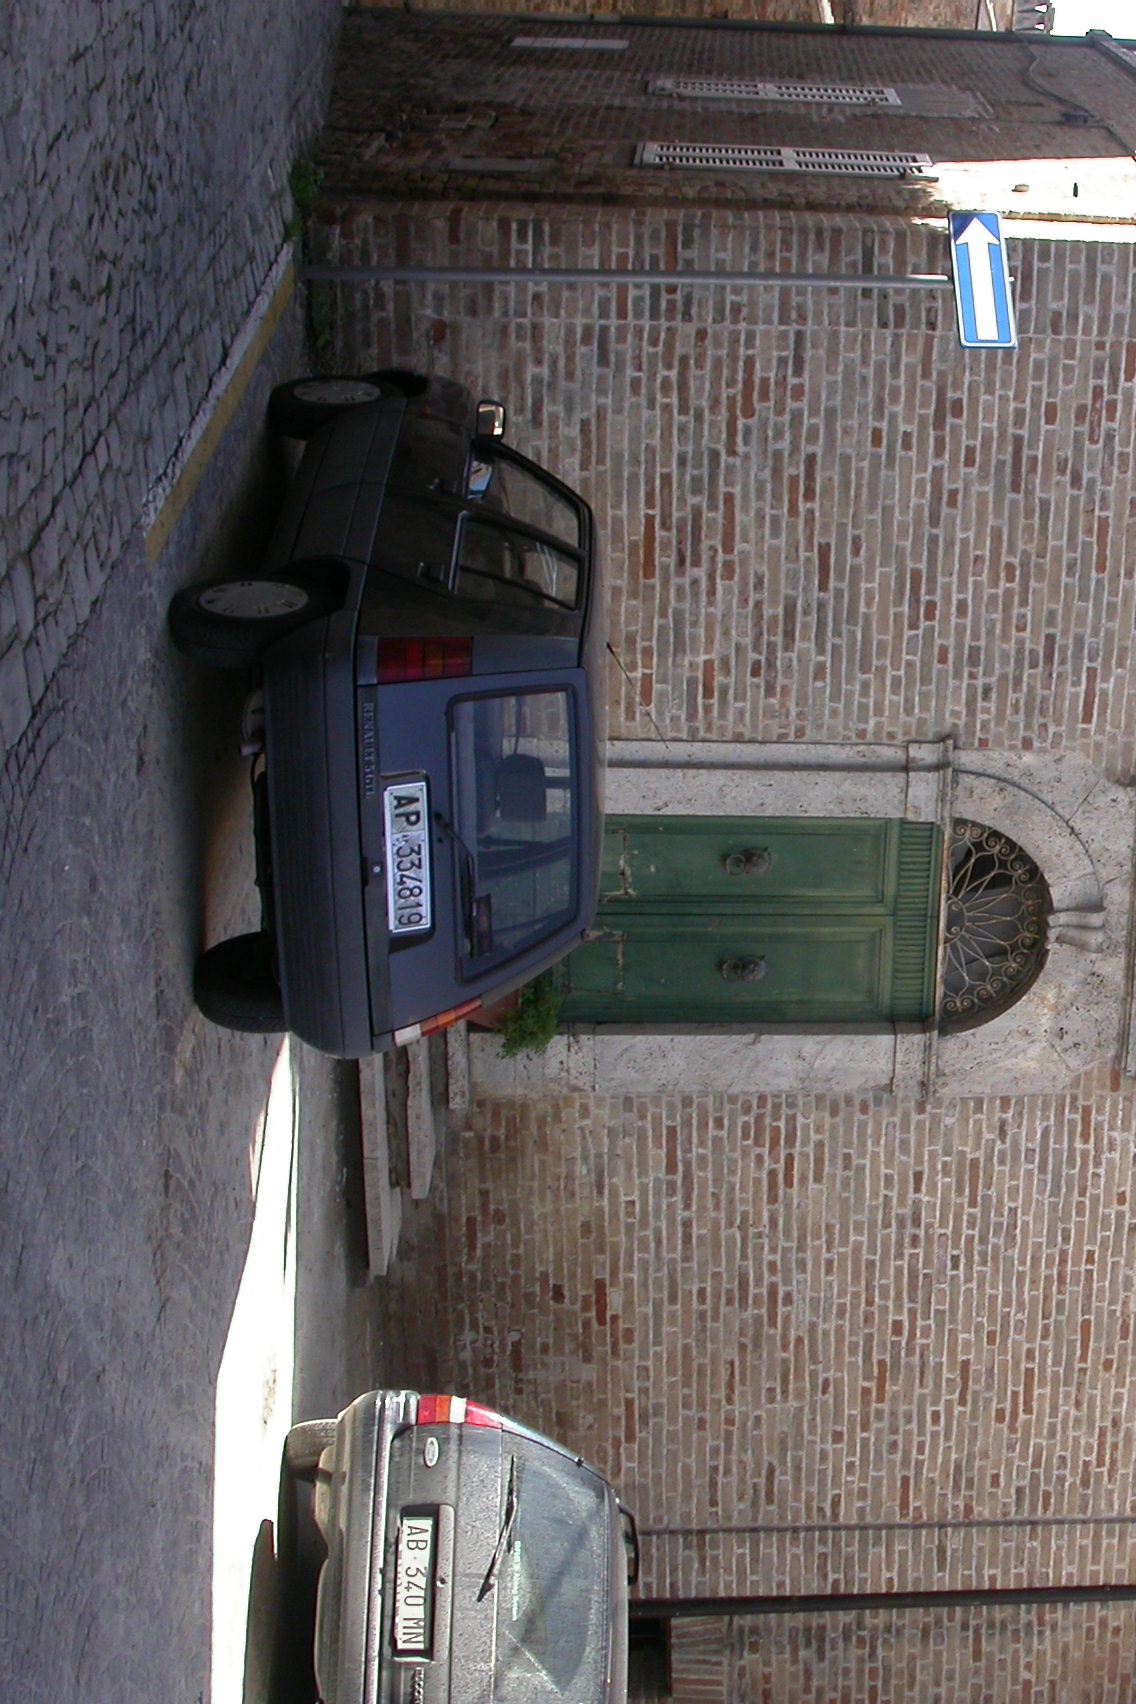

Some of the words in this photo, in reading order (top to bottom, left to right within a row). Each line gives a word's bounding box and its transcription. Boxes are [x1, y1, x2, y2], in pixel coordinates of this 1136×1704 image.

[364, 703, 375, 761] RENAULT
[365, 774, 376, 799] GTL
[393, 795, 421, 826] AP
[395, 844, 423, 926] 334819
[406, 1525, 429, 1551] AB
[403, 1566, 427, 1607] 340
[402, 1617, 424, 1644] MN
